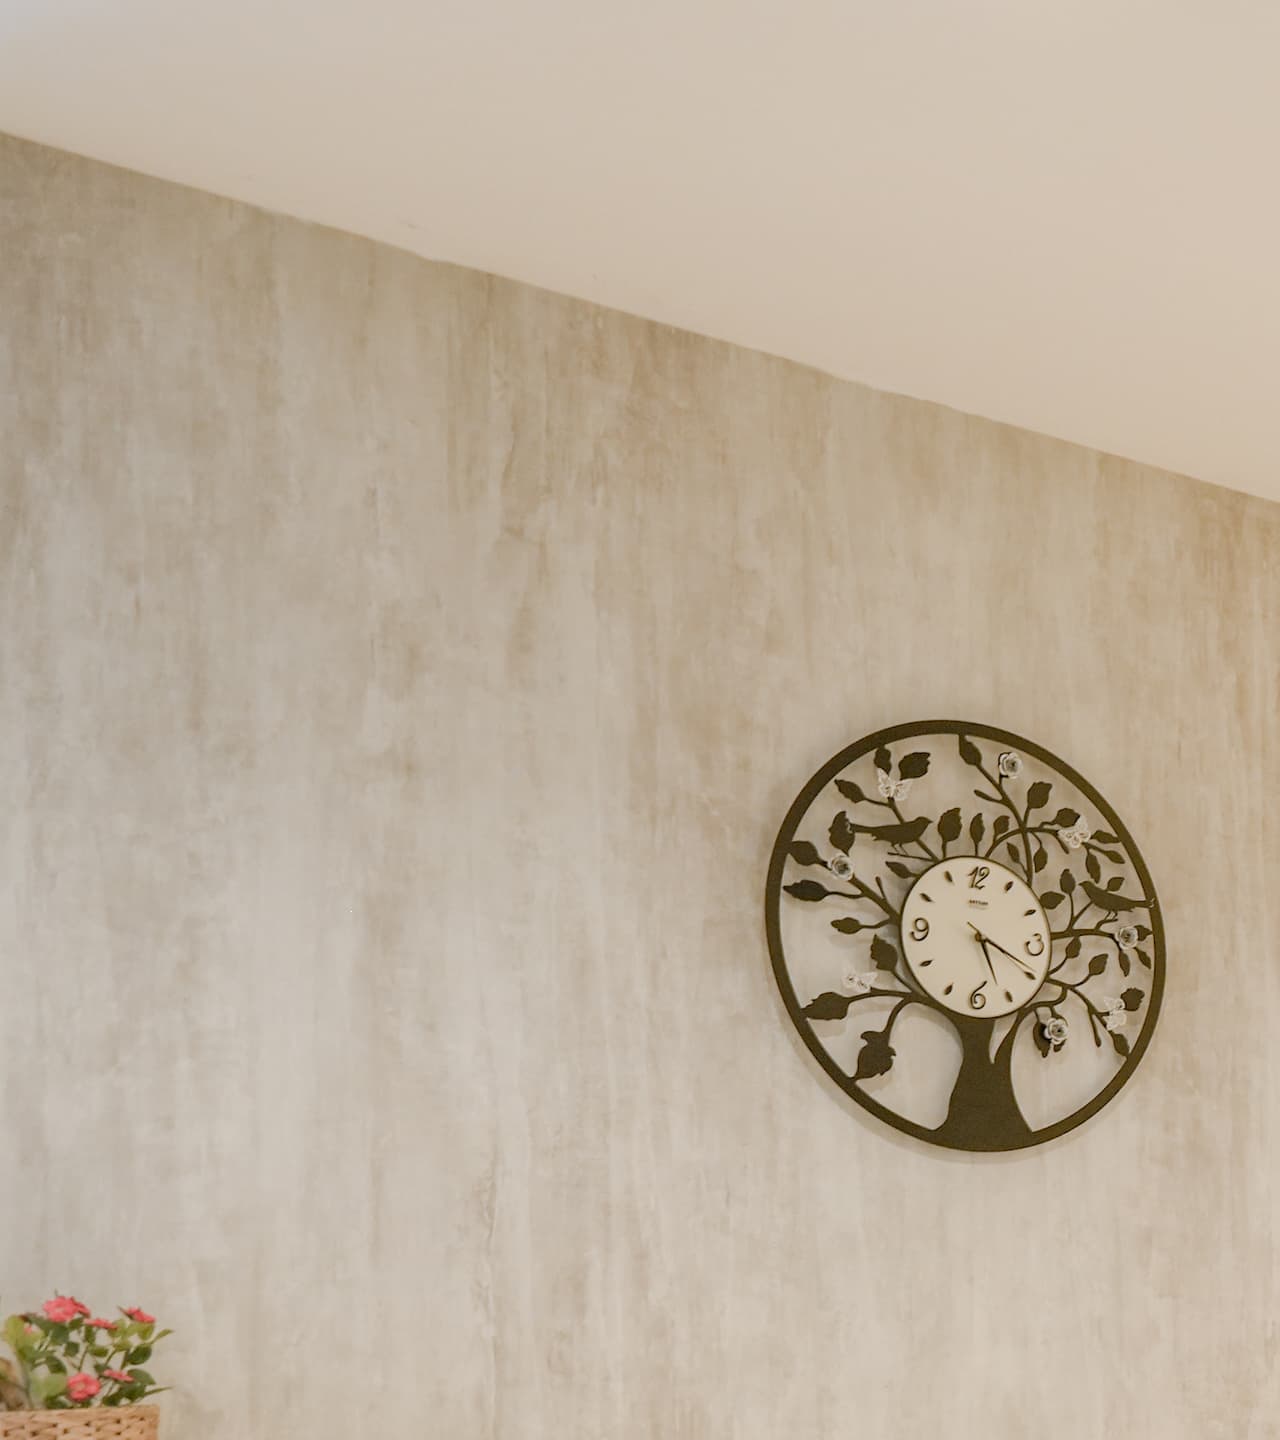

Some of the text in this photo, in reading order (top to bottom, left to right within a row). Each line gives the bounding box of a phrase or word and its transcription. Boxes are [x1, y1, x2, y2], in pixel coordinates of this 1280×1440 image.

[967, 866, 990, 890] 12
[910, 917, 930, 942] 9
[1025, 933, 1044, 956] 3
[970, 980, 987, 1010] 6
